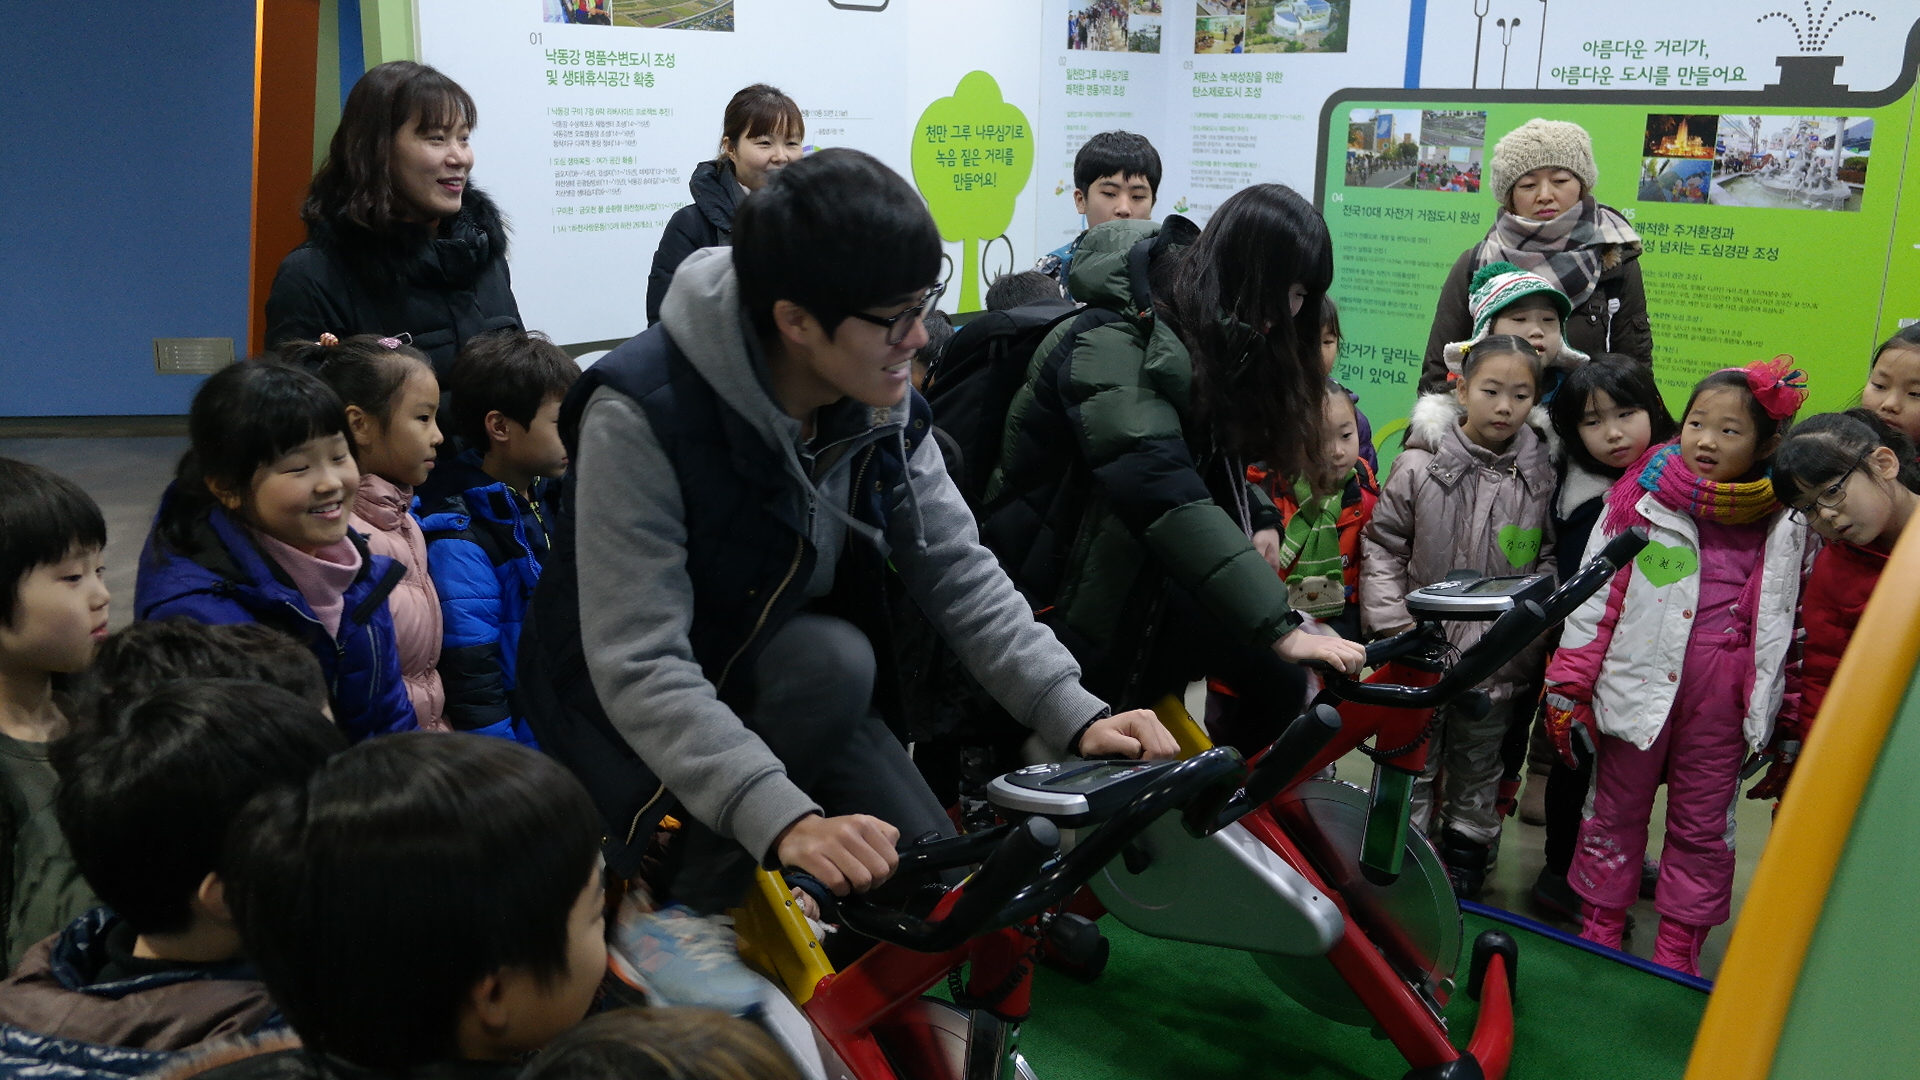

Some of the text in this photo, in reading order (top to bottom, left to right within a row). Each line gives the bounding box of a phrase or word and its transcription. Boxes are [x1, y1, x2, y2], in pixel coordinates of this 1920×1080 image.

[529, 32, 542, 45] 01
[546, 48, 676, 68] 낙동강 명품수변도시 조성
[1583, 39, 1710, 60] 아름다운 거리가,
[1059, 56, 1066, 66] 02
[1183, 60, 1194, 70] 03
[546, 70, 655, 88] 및 생태휴식공간 확충
[1066, 68, 1130, 82] 일천만그루 나무심기로
[1193, 71, 1283, 84] 저탄소 녹색성장을 위한
[1551, 66, 1747, 86] 아름다운 도시를 만들어요
[1066, 84, 1125, 97] 쾌적한 명품거리 조성
[1192, 86, 1262, 98] 탄소제로도시 조성
[552, 108, 570, 116] 낙동강
[926, 124, 1024, 142] 천만 그루 나무심기로
[936, 148, 1014, 167] 녹음 짙은 거리를
[954, 172, 997, 191] 만들어요!
[1332, 192, 1344, 202] 04
[1342, 204, 1480, 224] 전국10대 자전거 거점도시 완성
[1634, 222, 1735, 241] 쾌적한 주거환경과
[1640, 240, 1780, 262] 성 넘치는 도심경관 조성
[1339, 342, 1422, 368] 전거가 달리는
[1339, 363, 1408, 385] 길이 있어요
